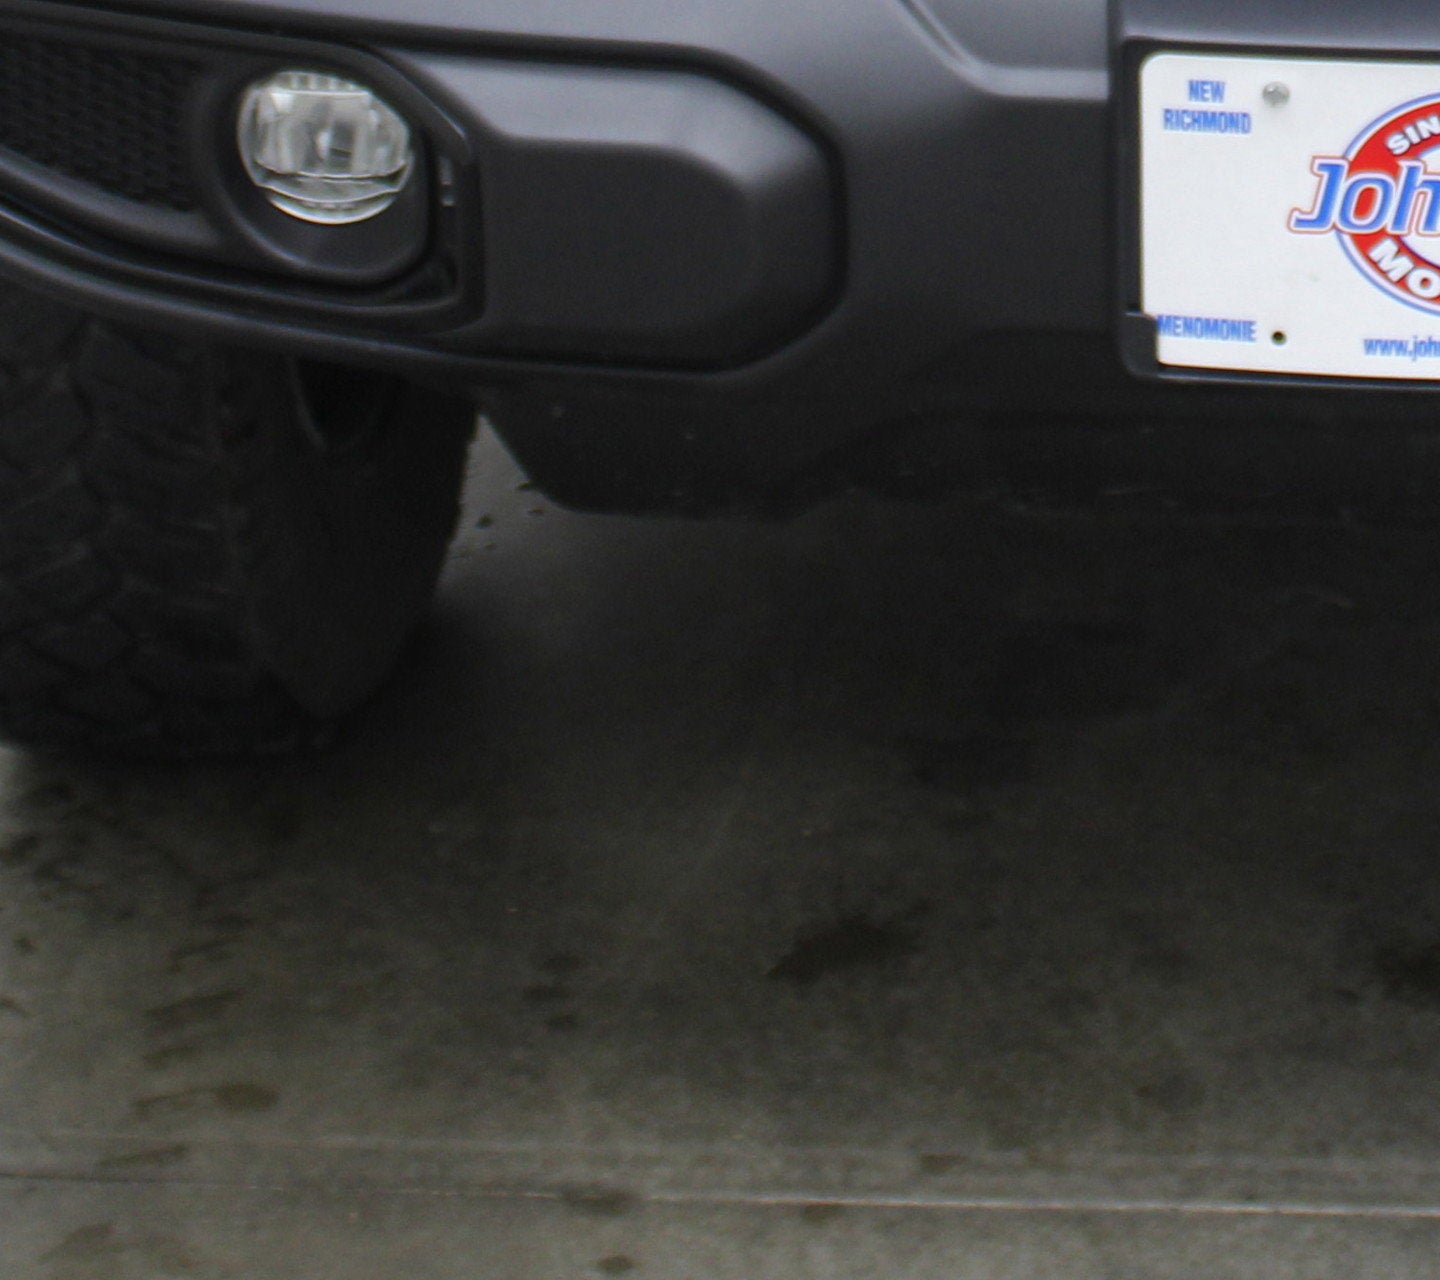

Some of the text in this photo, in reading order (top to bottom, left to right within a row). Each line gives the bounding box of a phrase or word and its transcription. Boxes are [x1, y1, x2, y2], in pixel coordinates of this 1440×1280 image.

[1188, 79, 1226, 103] NEW
[1163, 108, 1252, 134] RICHMOND
[1157, 315, 1257, 342] MENOMONIE
